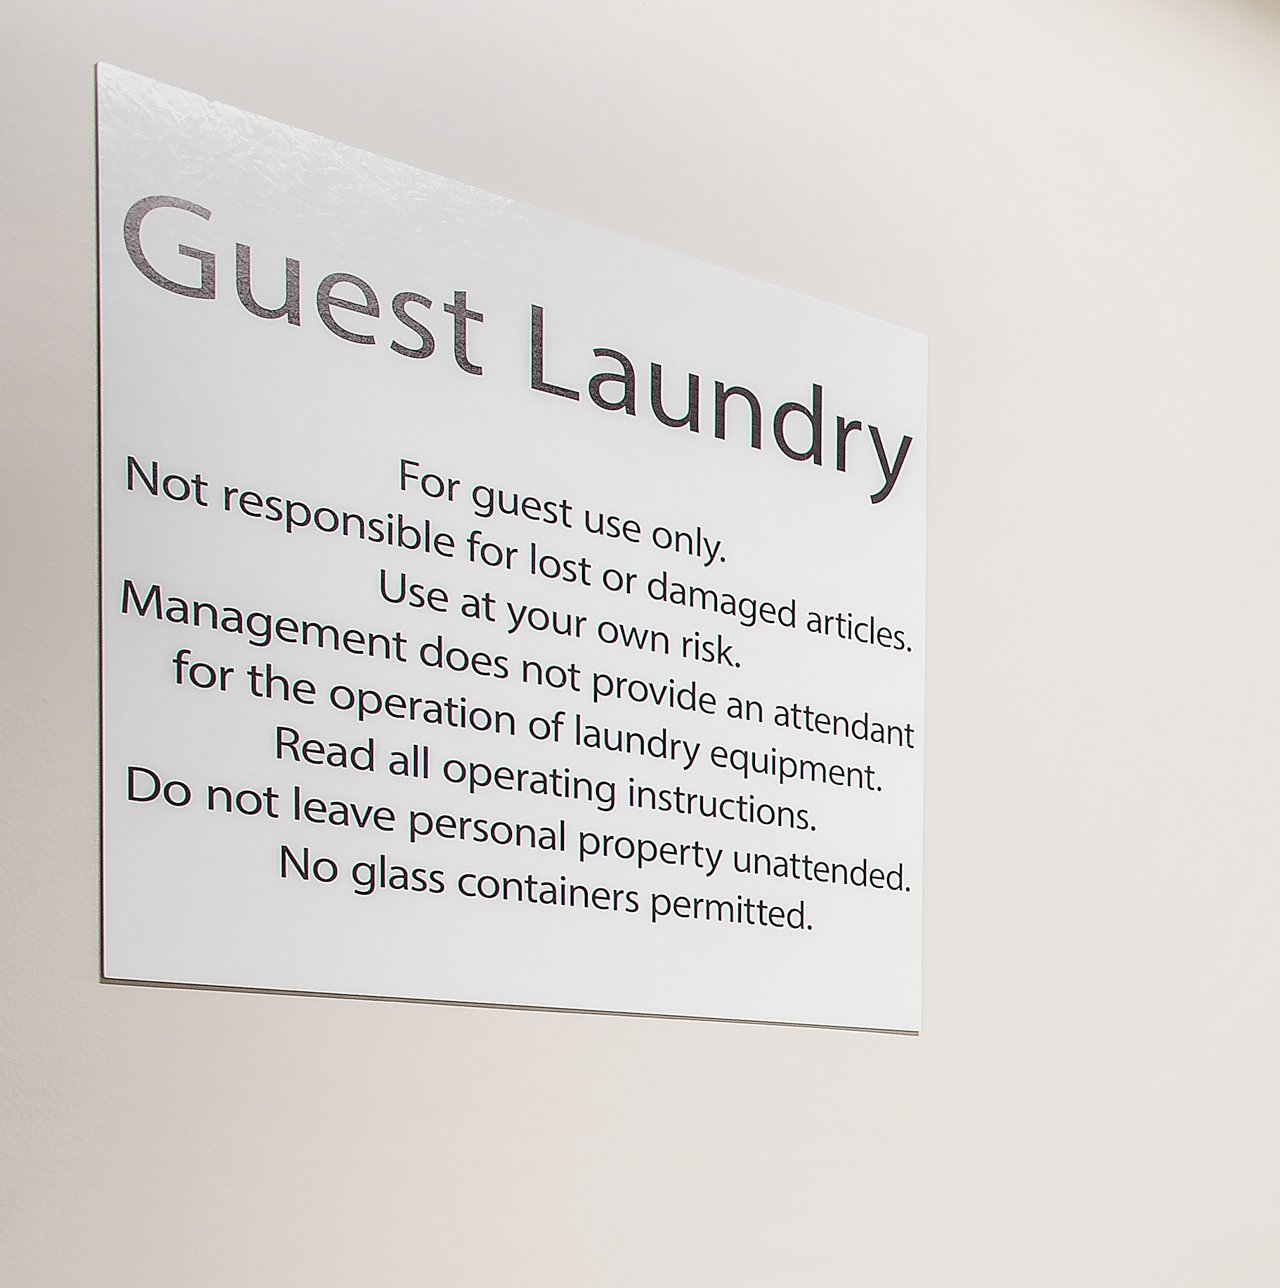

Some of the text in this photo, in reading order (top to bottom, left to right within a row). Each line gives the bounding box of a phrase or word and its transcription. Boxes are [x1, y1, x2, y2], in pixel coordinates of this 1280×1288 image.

[124, 196, 912, 504] Guest Laundry
[128, 456, 911, 652] Not responsible for lost or damaged articles.
[401, 459, 725, 567] For guest use only.
[122, 580, 914, 748] Management does not provide an attendant
[381, 569, 740, 668] Use at your own risk.
[173, 650, 881, 791] for the operation of laundry equipment.
[277, 727, 815, 831] Read all operating instructions.
[128, 767, 910, 892] Do not leave personal property unattended.
[282, 846, 812, 930] No glass containers permitted.
